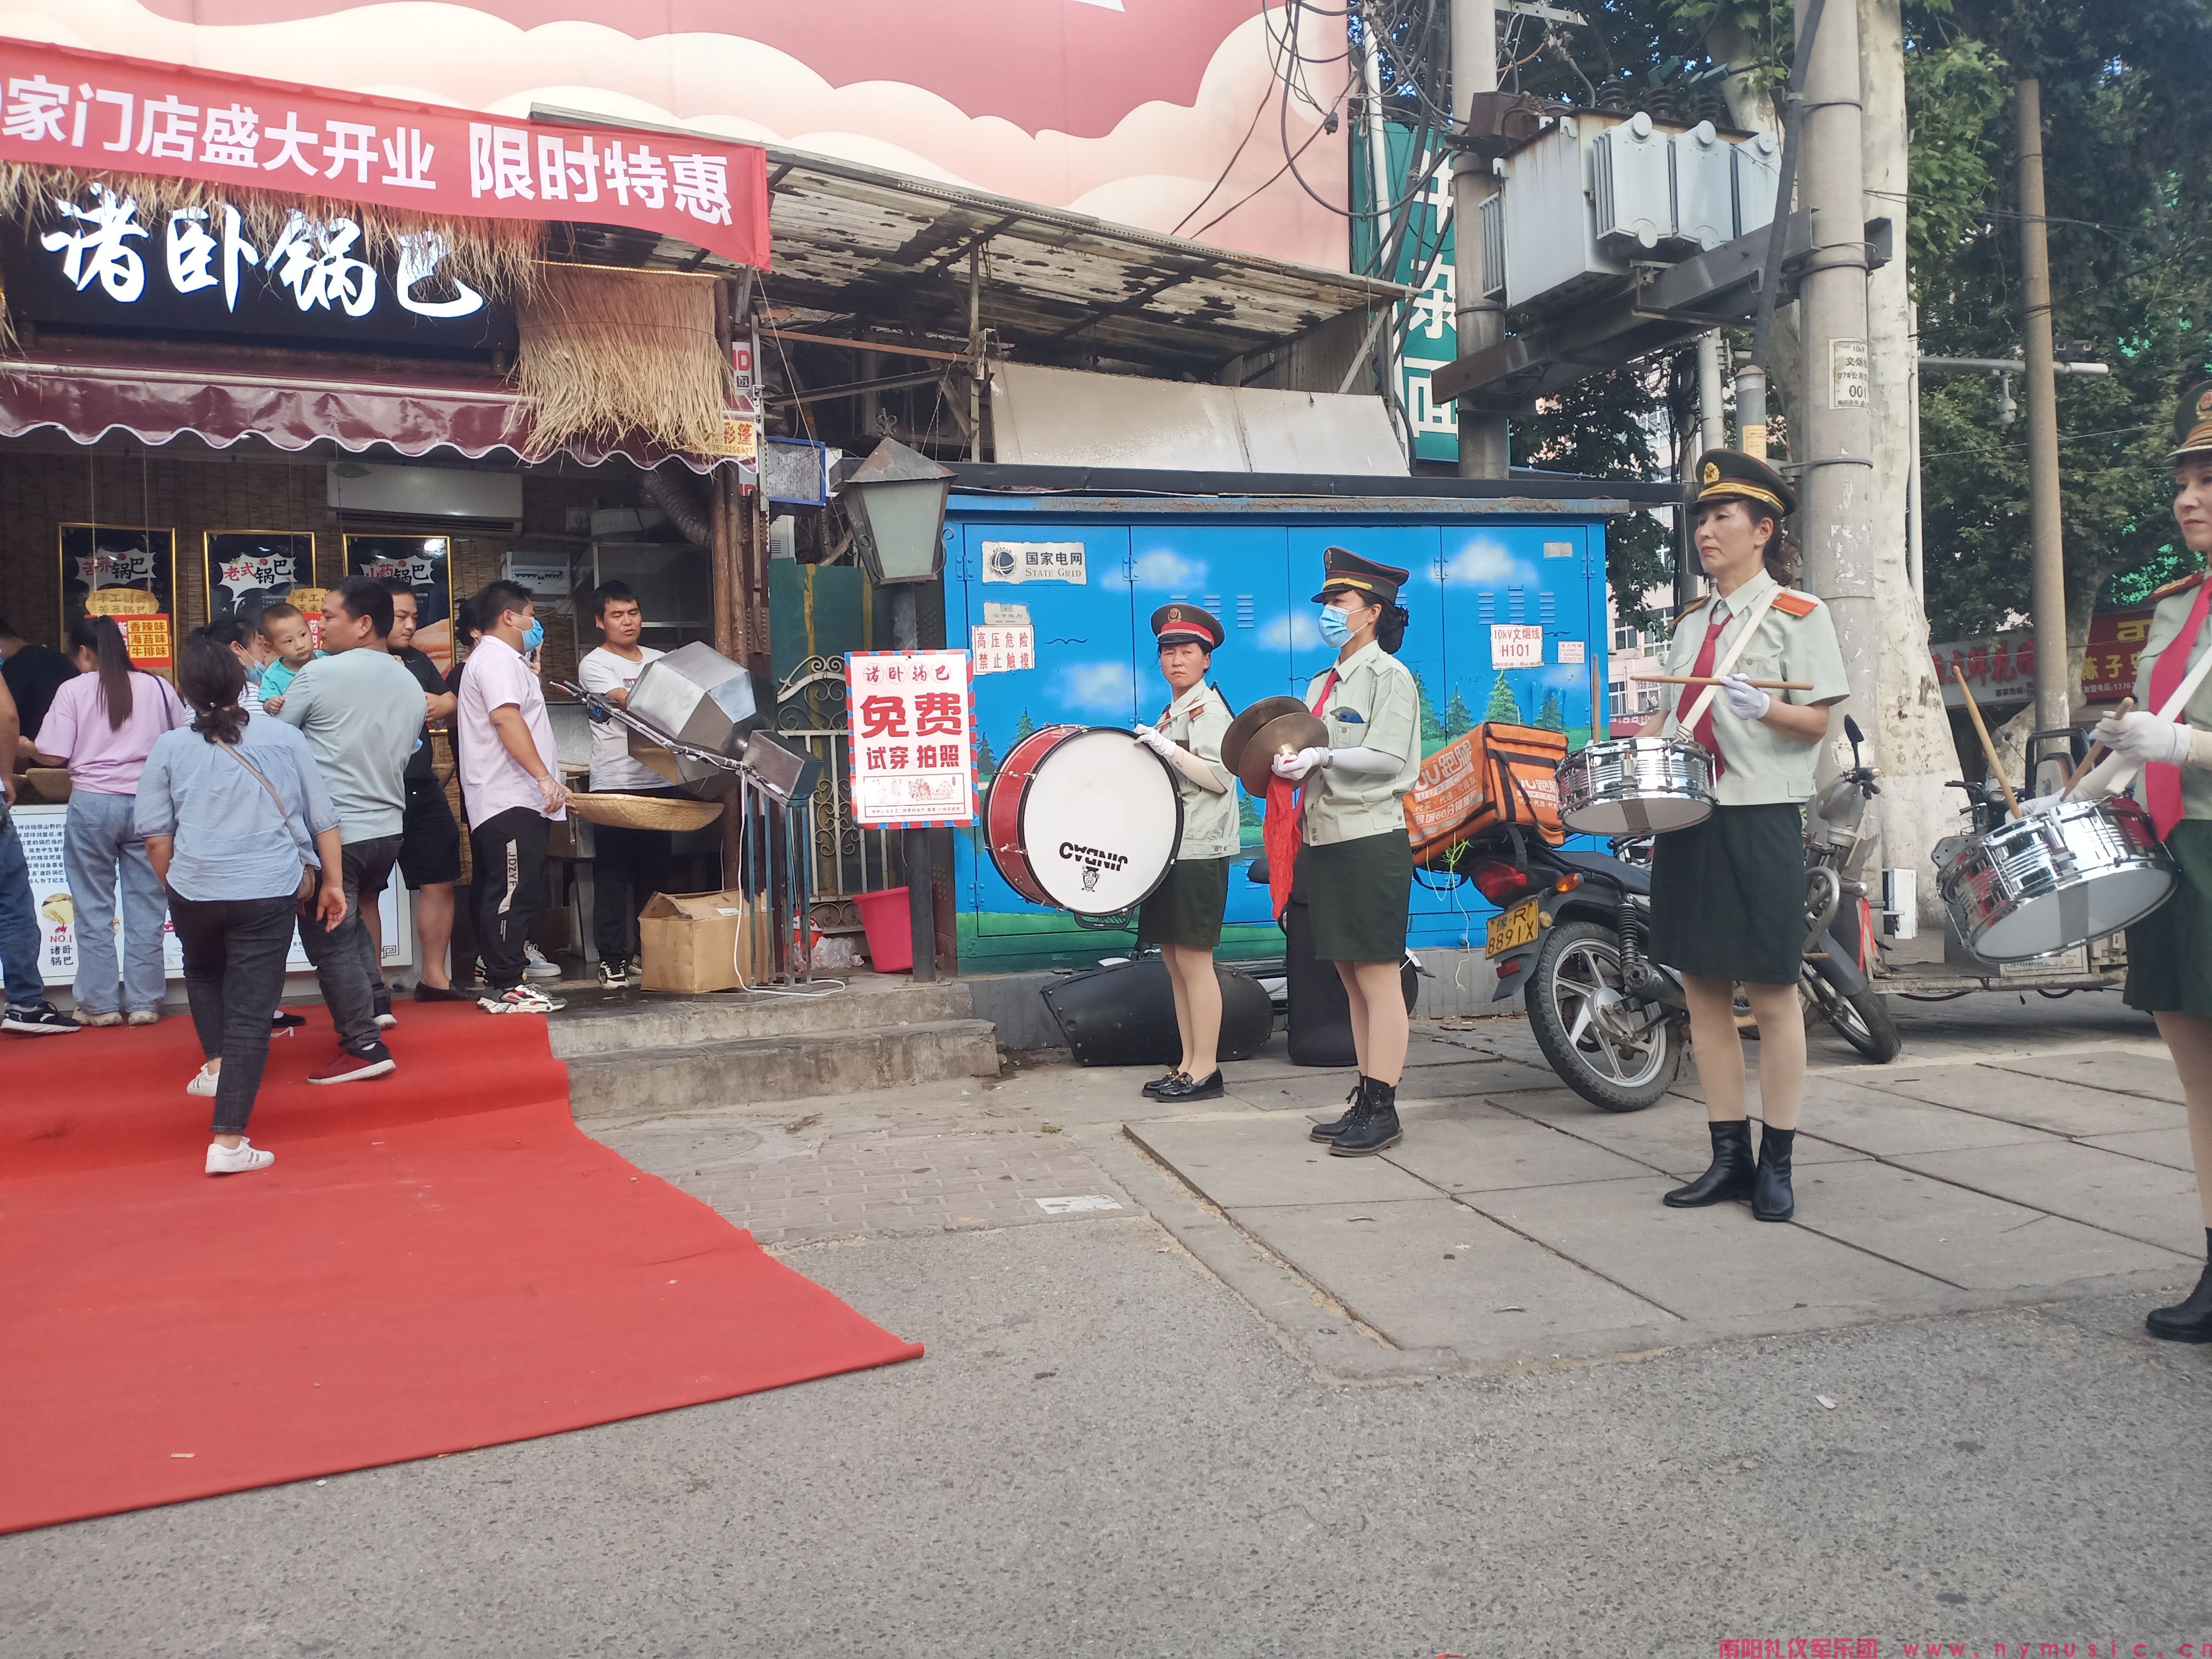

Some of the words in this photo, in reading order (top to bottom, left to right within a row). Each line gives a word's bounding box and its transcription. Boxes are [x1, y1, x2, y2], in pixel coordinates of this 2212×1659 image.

[0, 74, 436, 190] 家门店盛大开业
[469, 122, 733, 226] 限时特惠
[41, 182, 484, 318] 诸卧锅巴
[1026, 551, 1082, 566] 国家电网
[224, 559, 292, 584] 老式锅巴
[1025, 568, 1054, 577] STATE
[1058, 568, 1081, 578] GRID
[297, 592, 325, 602] 手工
[131, 622, 166, 632] 香辣味
[131, 634, 166, 644] 海苔味
[977, 631, 1028, 649] 高压危险
[132, 647, 167, 656] 牛排味
[1502, 644, 1529, 657] H101
[979, 652, 1029, 669] 禁止触摸
[865, 662, 950, 682] 诸卧锅巴
[860, 692, 962, 738] 免费
[508, 851, 518, 887] JDZYF
[1488, 921, 1534, 955] 8891X
[50, 946, 73, 955] 诸卧
[50, 957, 74, 966] 锅巴
